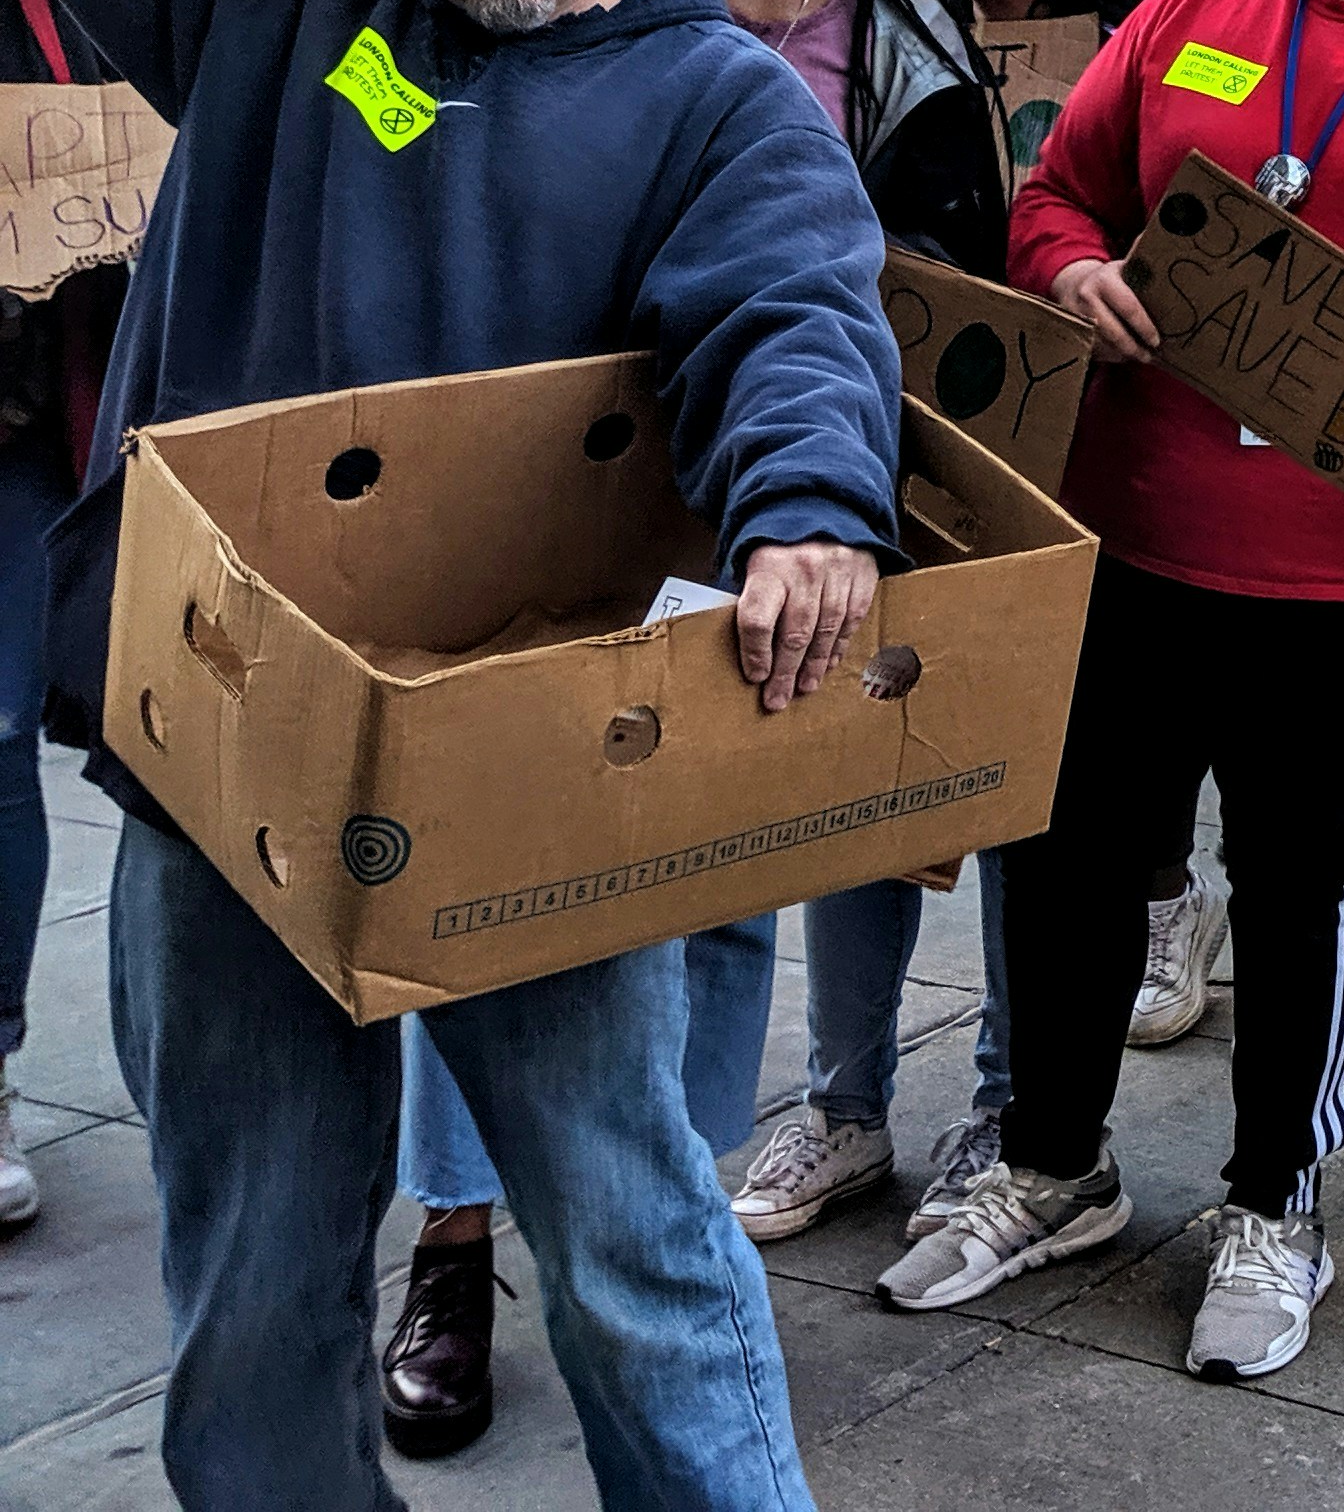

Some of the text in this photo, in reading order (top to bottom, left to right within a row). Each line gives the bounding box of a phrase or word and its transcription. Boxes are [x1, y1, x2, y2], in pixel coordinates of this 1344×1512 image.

[359, 38, 434, 118] LONDON CALLING
[1187, 49, 1259, 76] LONDON CALLING
[54, 189, 147, 248] SU
[1161, 259, 1340, 416] SAVE
[450, 915, 458, 928] 1
[480, 906, 492, 922] 2
[512, 899, 524, 914] 3
[544, 891, 555, 906] 4
[575, 884, 587, 899] 5
[606, 876, 617, 891] 6
[637, 868, 648, 883] 7
[666, 860, 677, 875] 8
[719, 843, 737, 859] 10
[750, 834, 764, 850] 11
[776, 827, 792, 843] 12
[803, 819, 819, 835] 13
[829, 812, 848, 829] 14
[856, 804, 873, 819] 15
[882, 796, 898, 813] 16
[907, 789, 925, 805] 17
[959, 776, 974, 792] 19
[982, 769, 999, 785] 20
